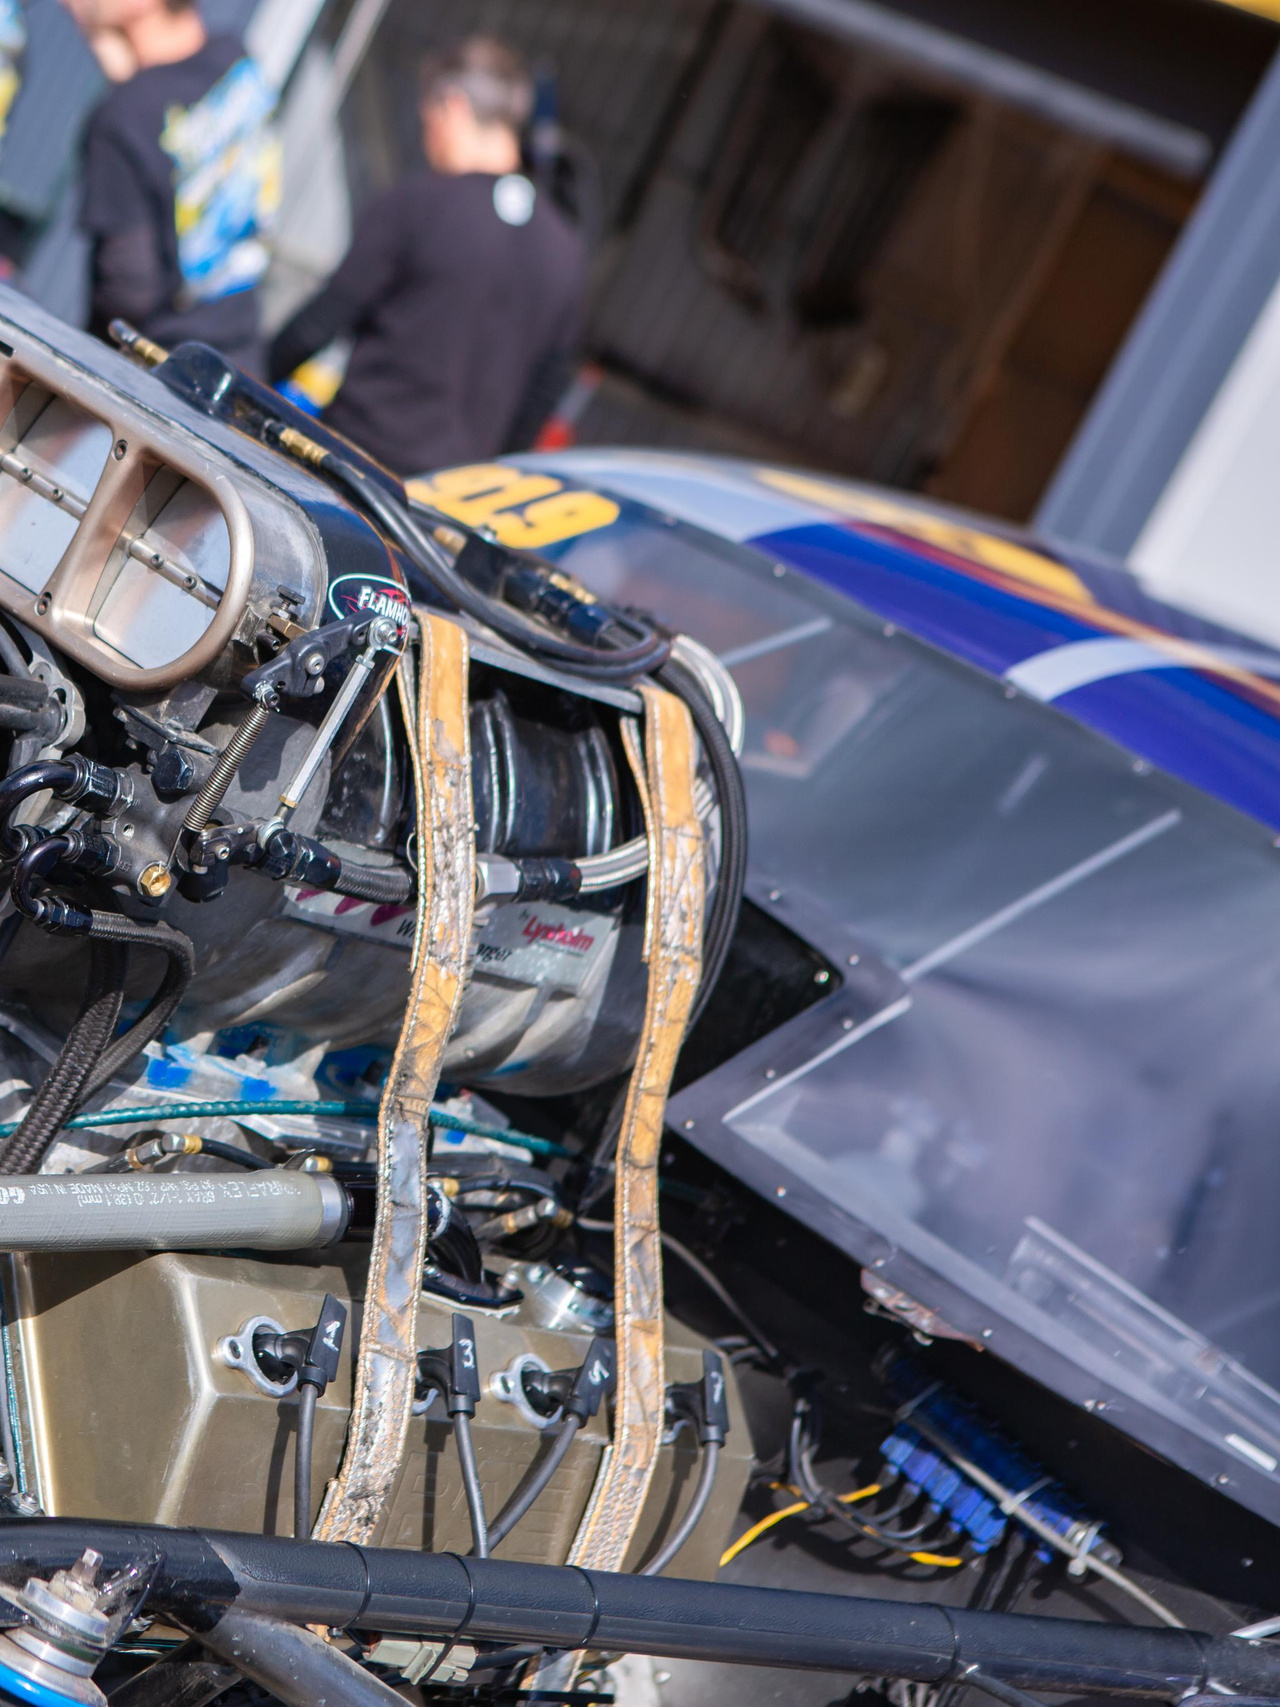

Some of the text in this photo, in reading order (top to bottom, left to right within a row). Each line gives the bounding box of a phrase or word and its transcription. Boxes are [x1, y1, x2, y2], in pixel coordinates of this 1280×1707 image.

[29, 1183, 53, 1195] USA
[69, 1183, 103, 1195] MADE
[458, 1338, 475, 1369] 3
